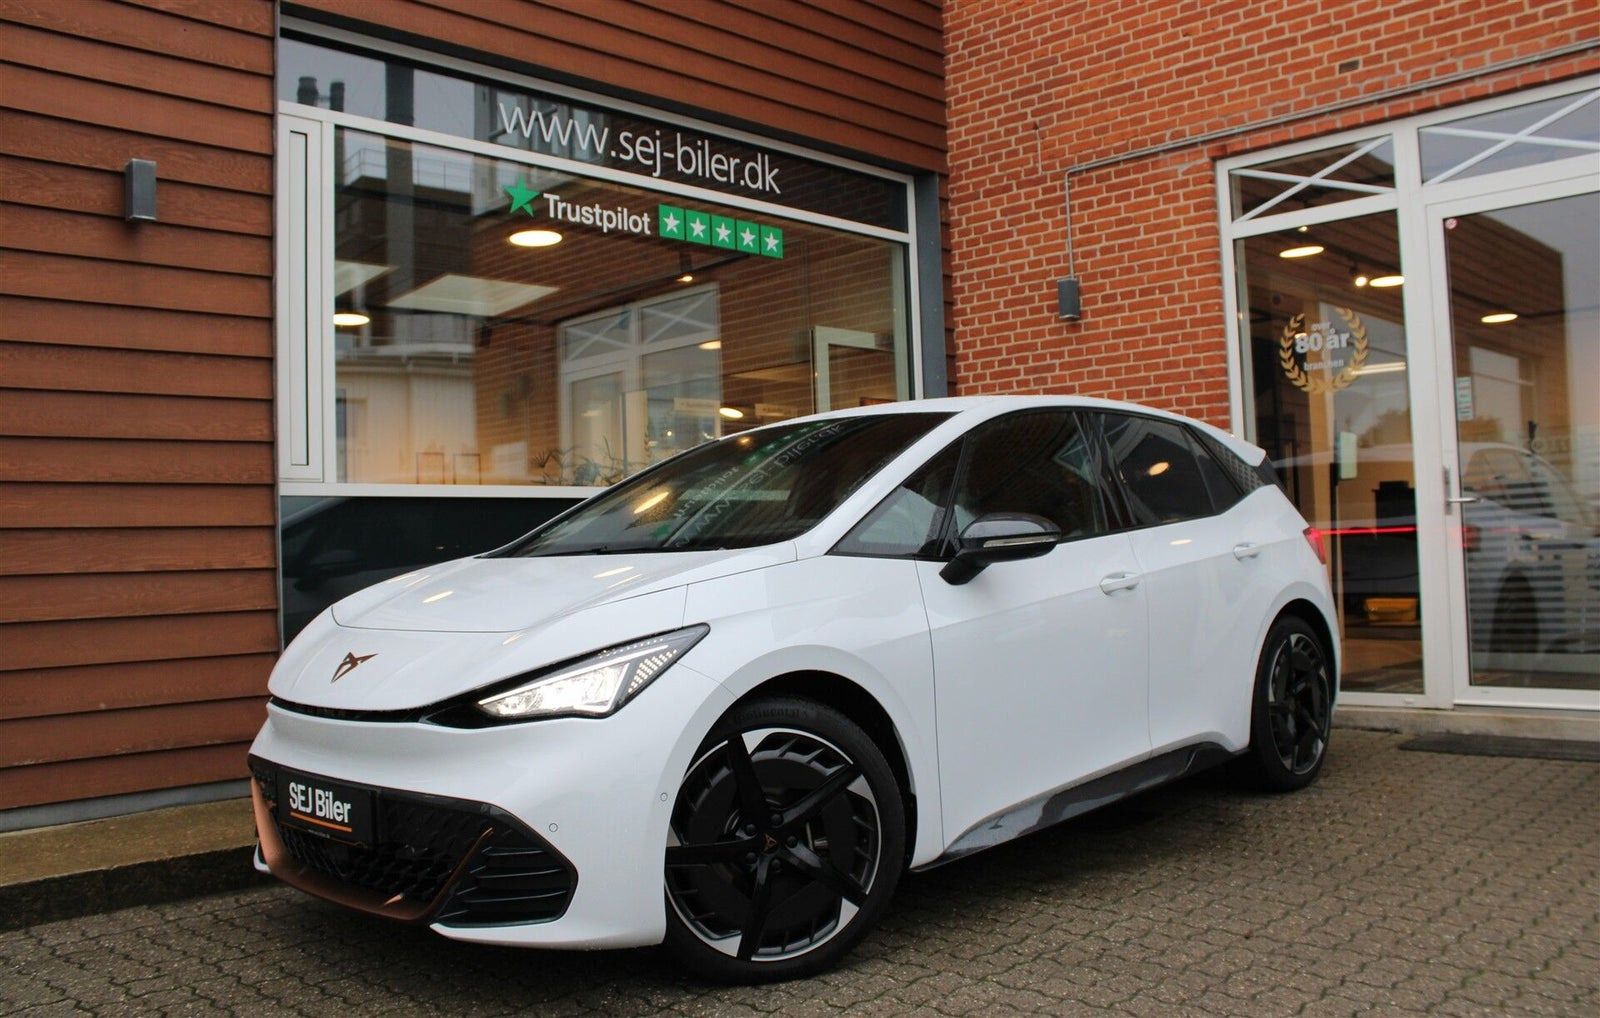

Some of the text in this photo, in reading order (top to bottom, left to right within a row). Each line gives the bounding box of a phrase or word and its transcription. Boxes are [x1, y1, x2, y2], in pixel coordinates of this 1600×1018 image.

[499, 102, 782, 195] www.sej-biler.dk
[543, 192, 651, 235] Trustpilot
[1295, 328, 1350, 353] 80 år
[289, 781, 351, 823] SEJ Biler
